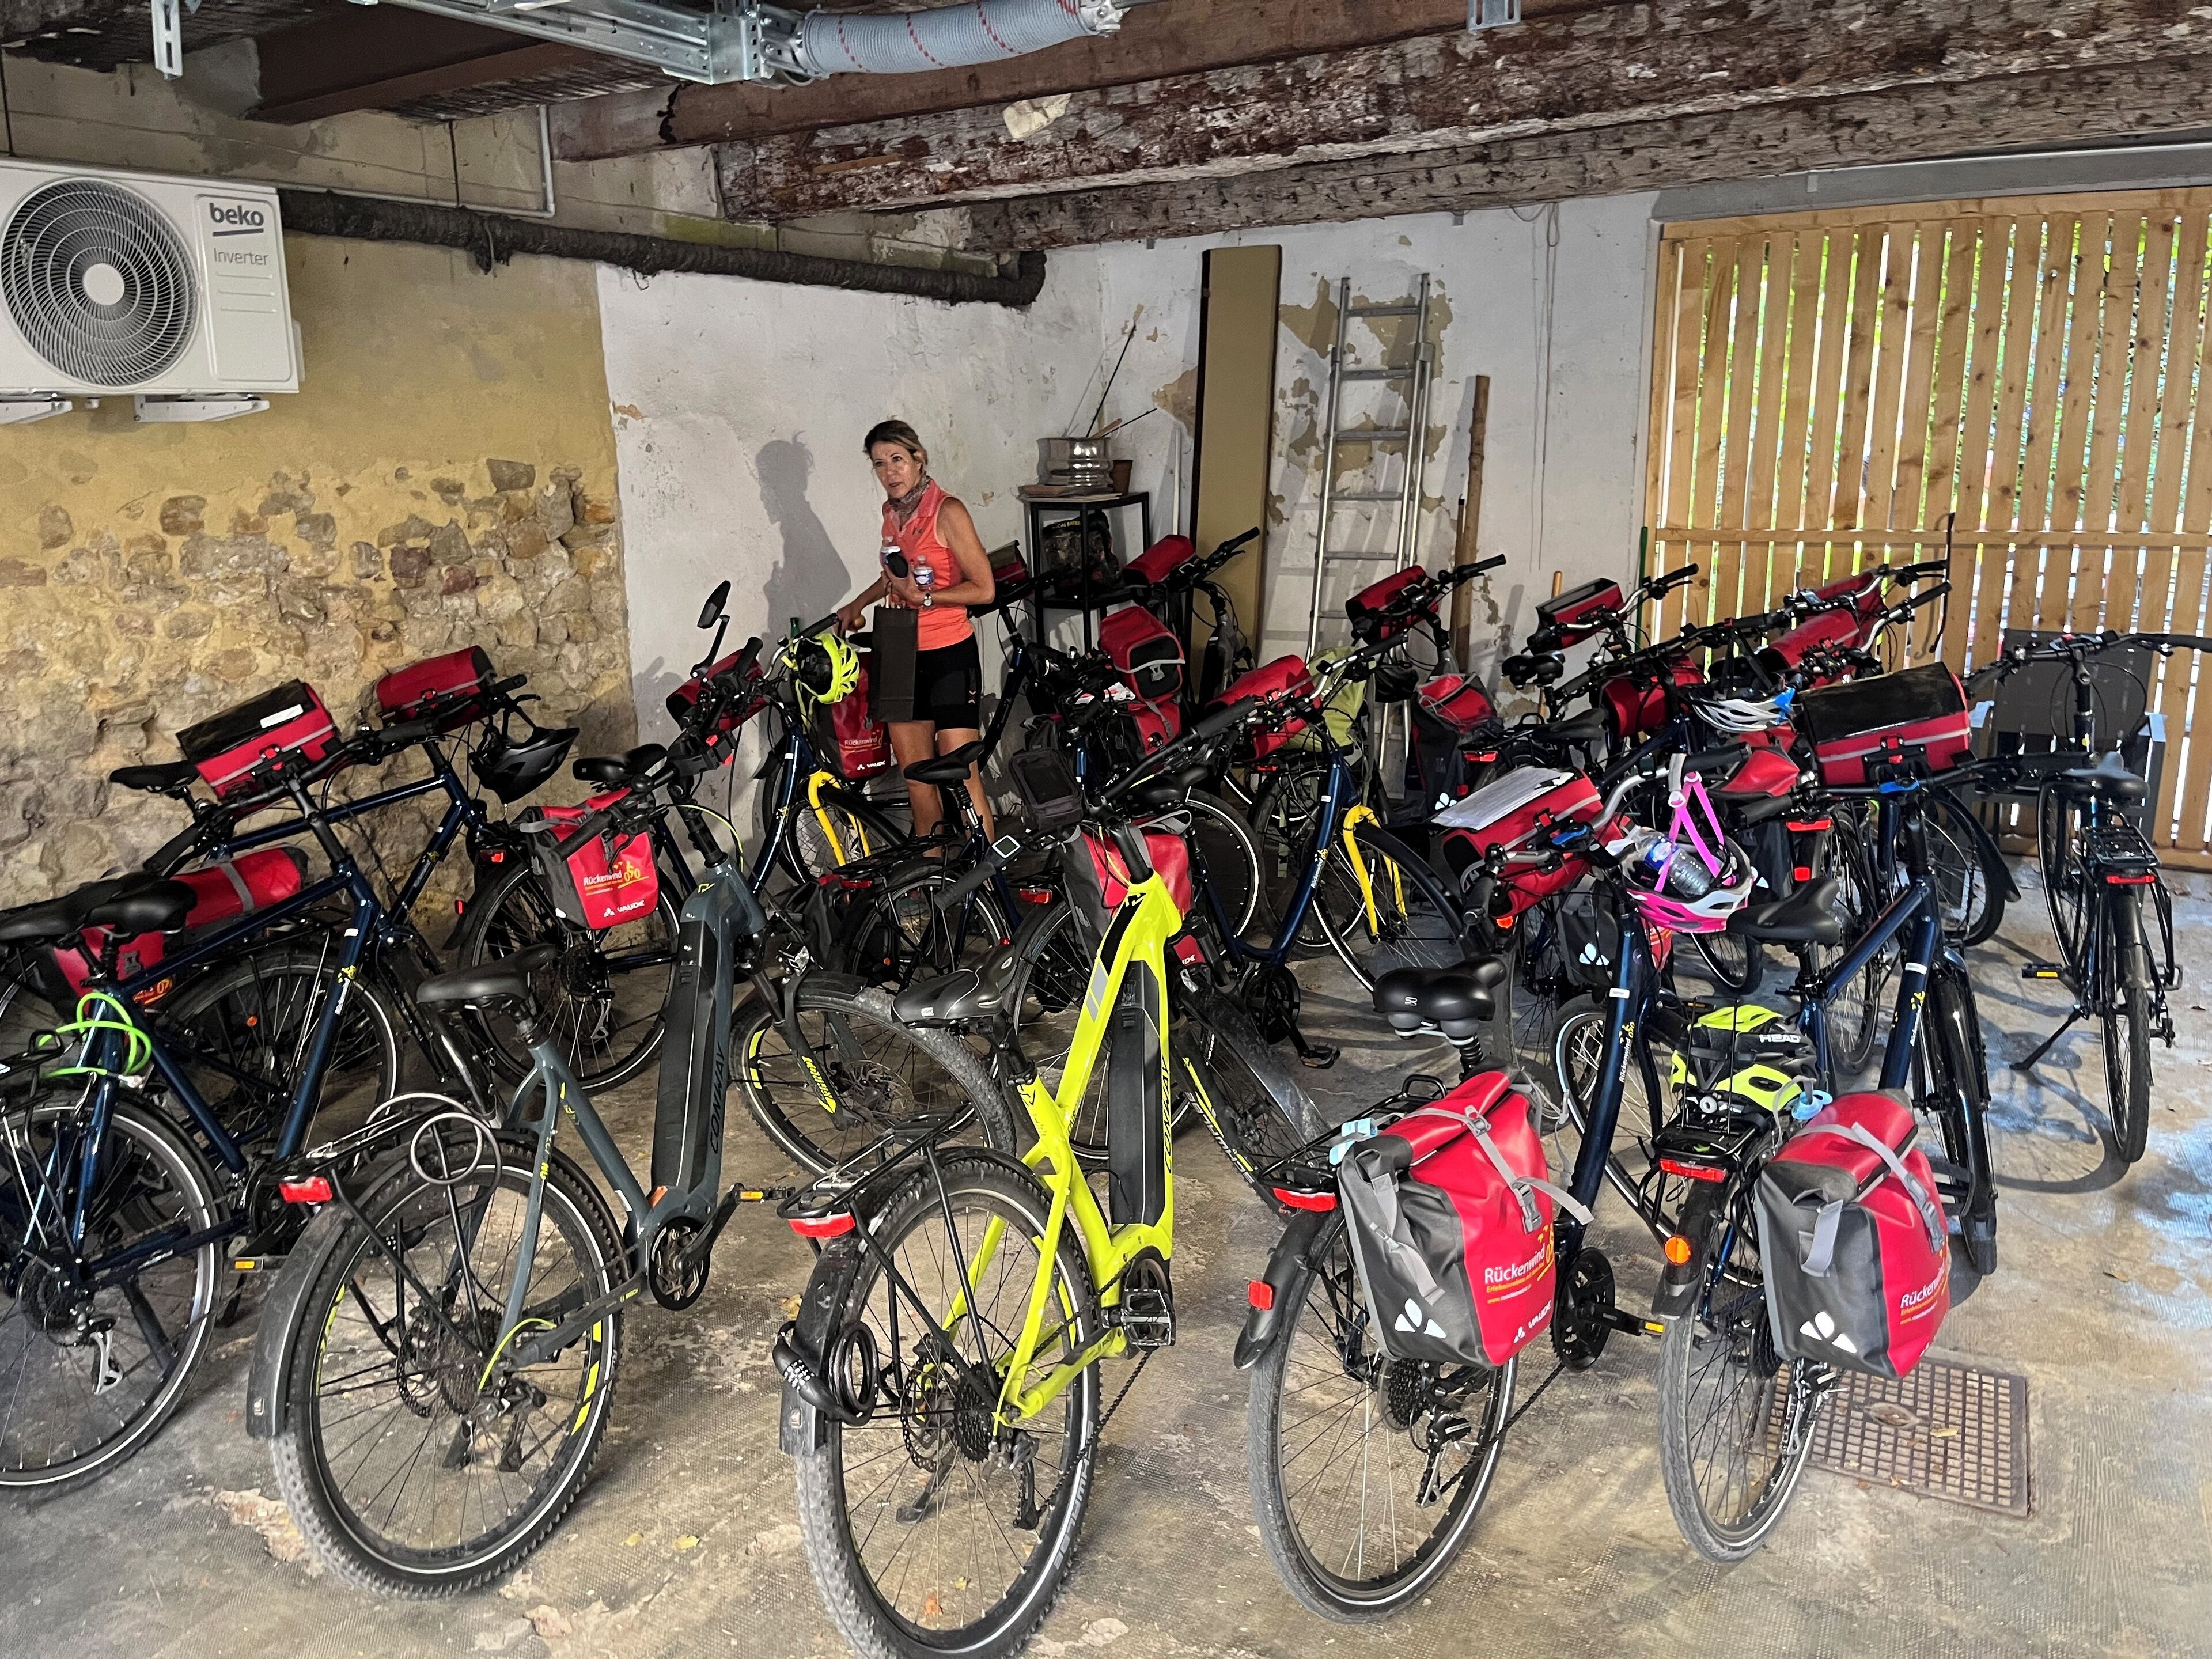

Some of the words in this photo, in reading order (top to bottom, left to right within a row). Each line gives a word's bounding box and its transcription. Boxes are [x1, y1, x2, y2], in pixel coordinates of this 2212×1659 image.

[209, 202, 264, 226] beko
[213, 248, 269, 266] Inverter
[616, 900, 645, 913] VAUDE
[1759, 1033, 1801, 1043] HEAD
[1619, 1037, 1631, 1083] Rückenwind
[710, 1040, 725, 1155] CONWAY
[1161, 1055, 1172, 1174] CONWAY
[1184, 1092, 1255, 1184] SCHWALBE
[1484, 1243, 1546, 1285] Rückenwind
[1528, 1300, 1552, 1329] VAUDE
